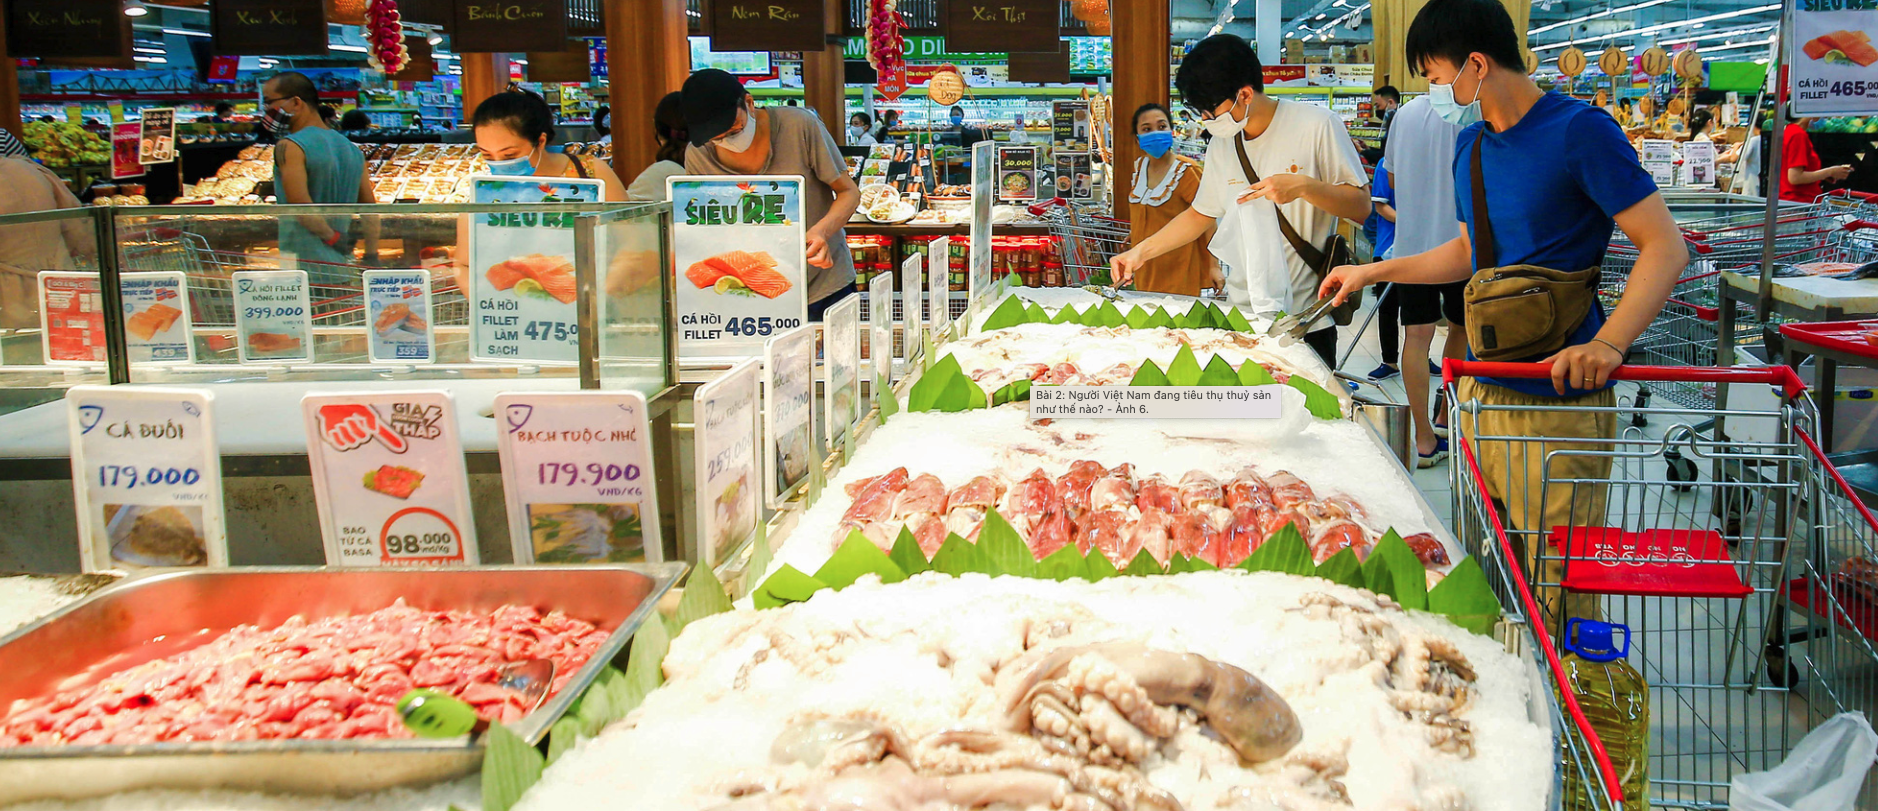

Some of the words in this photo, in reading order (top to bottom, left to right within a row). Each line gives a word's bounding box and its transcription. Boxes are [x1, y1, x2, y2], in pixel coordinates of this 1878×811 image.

[732, 5, 760, 20] Nem
[1798, 78, 1810, 87] CÁ
[1812, 78, 1828, 88] HỒI
[1830, 81, 1878, 96] 465.00
[1800, 91, 1828, 99] FILLET
[685, 198, 738, 225] SIÊU
[742, 181, 787, 225] RẺ
[275, 284, 301, 292] FILLET
[480, 298, 495, 310] CÁ
[497, 299, 519, 311] HỒI
[245, 306, 304, 319] 399.000
[483, 315, 519, 326] FILLET
[682, 313, 698, 325] CÁ
[700, 313, 721, 325] HỒI
[725, 316, 800, 337] 465.000
[495, 329, 519, 341] LÀM
[685, 330, 722, 340] FILLET
[397, 346, 418, 355] 359
[106, 420, 134, 439] CÁ
[139, 418, 184, 440] ĐUỐI
[517, 430, 557, 444] BẠCH
[560, 428, 606, 444] TUỘC
[99, 465, 200, 489] 179.000
[538, 463, 641, 486] 179.900
[597, 487, 642, 496] VND/KG
[343, 526, 366, 535] BAO
[386, 533, 451, 554] 98.000
[344, 548, 372, 557] BASA
